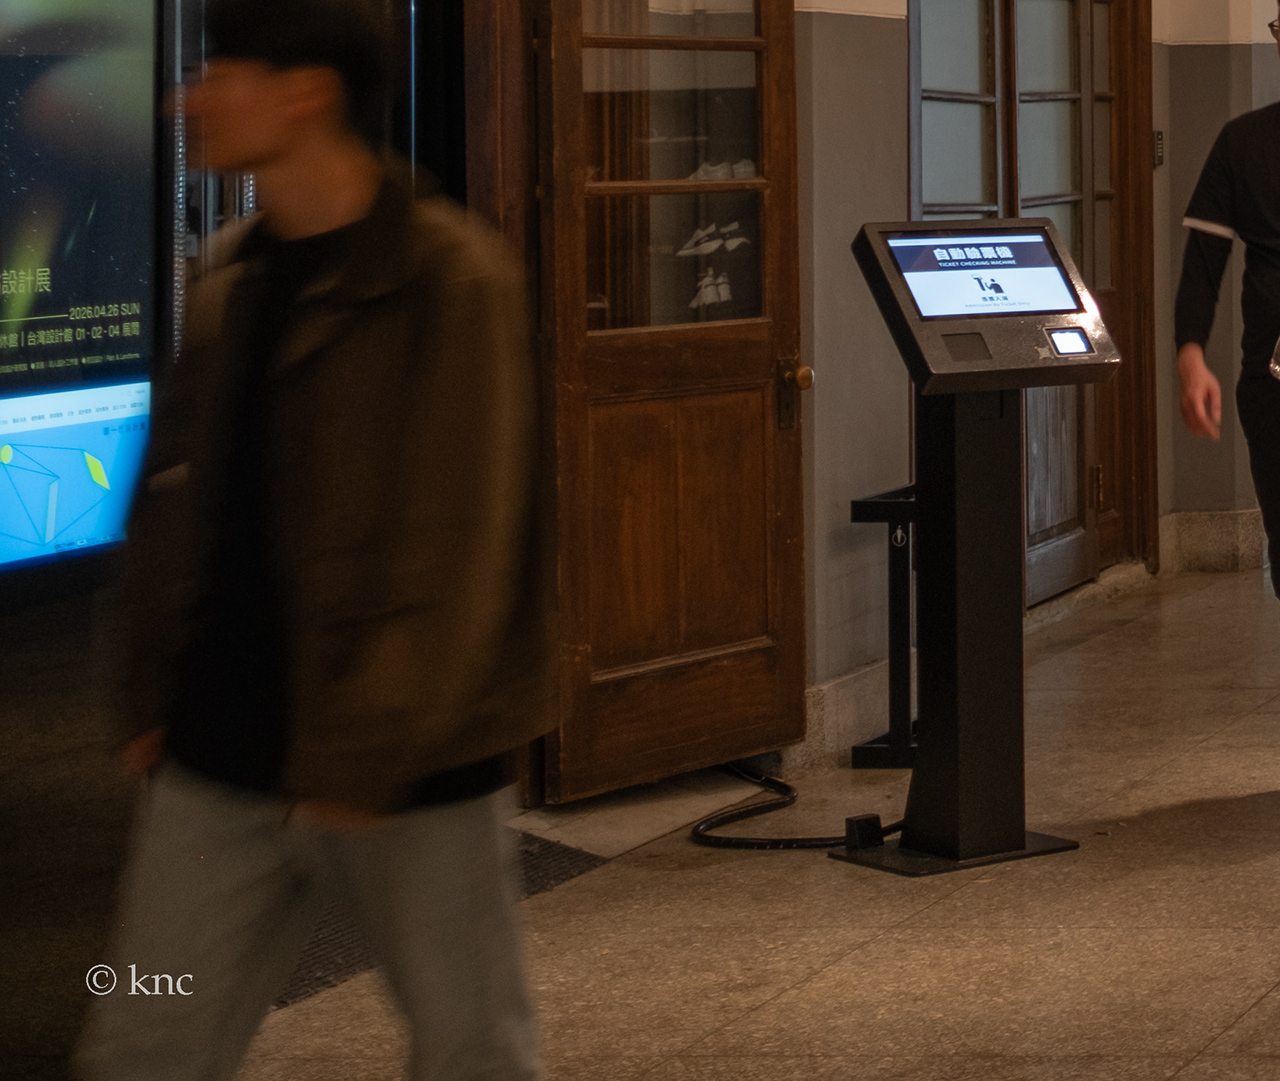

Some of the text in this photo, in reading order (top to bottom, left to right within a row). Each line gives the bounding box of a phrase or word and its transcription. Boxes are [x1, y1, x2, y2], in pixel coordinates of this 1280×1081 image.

[932, 245, 1014, 261] 自動驗票機
[1, 267, 52, 295] 設計展
[69, 302, 140, 321] 2026.04.26 SUN
